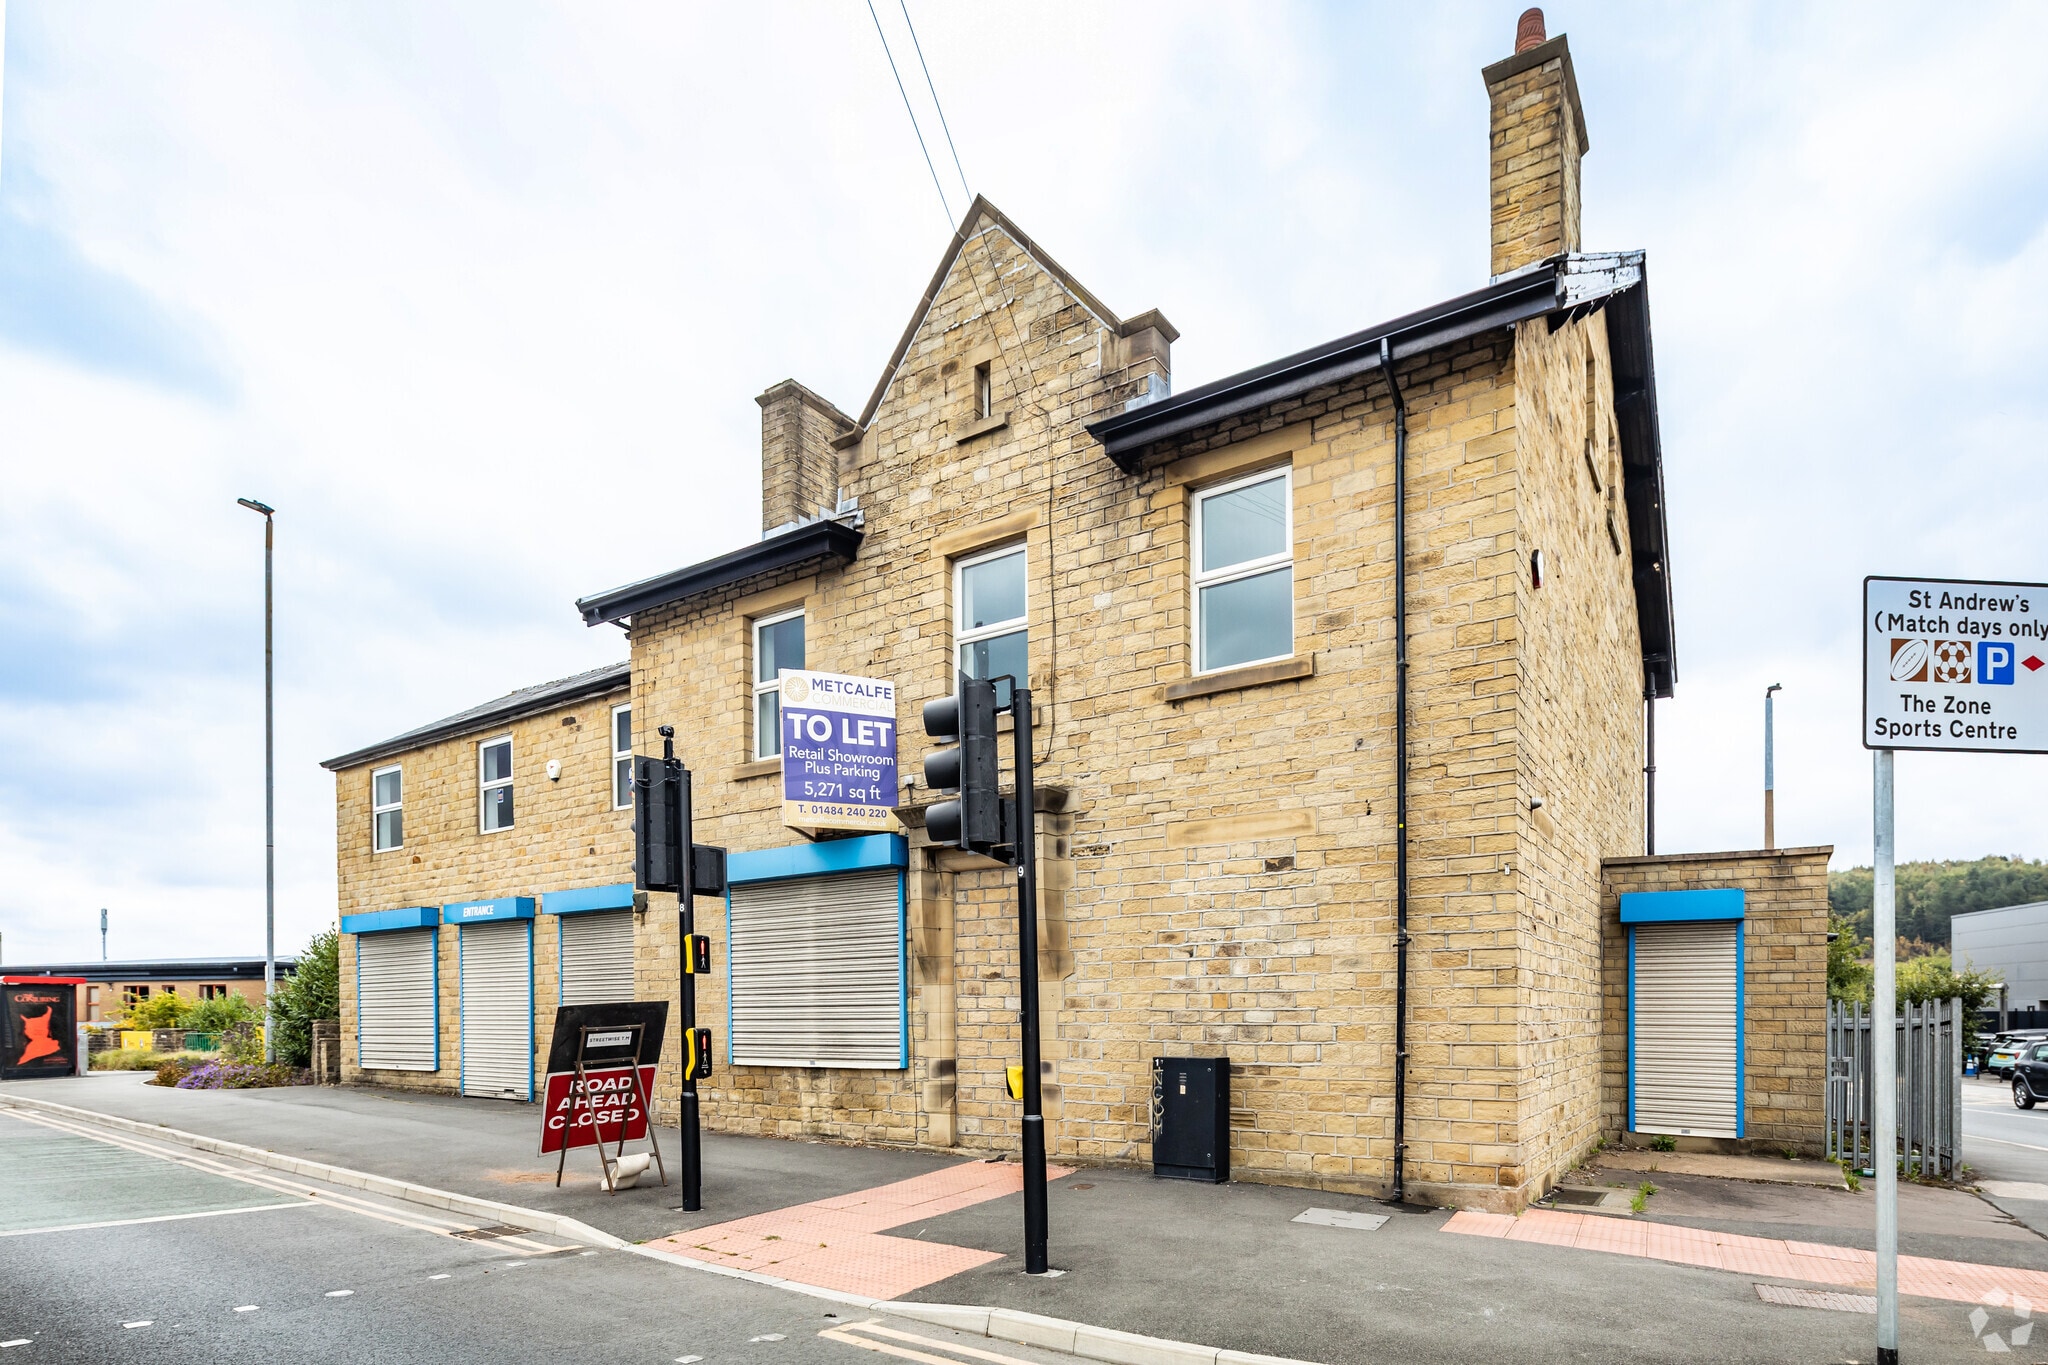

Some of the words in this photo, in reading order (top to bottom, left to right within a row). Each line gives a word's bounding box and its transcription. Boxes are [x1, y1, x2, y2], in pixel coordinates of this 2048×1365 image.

[1908, 590, 1931, 609] St
[1939, 591, 2030, 613] Andrew's
[1957, 616, 2002, 639] days
[1986, 646, 2009, 681] P
[812, 678, 892, 700] METCALFE
[812, 693, 893, 713] COMMERCIAL
[1900, 694, 1936, 713] The
[1943, 695, 1991, 715] Zone
[787, 712, 833, 742] TO
[842, 718, 892, 748] LET
[1874, 717, 1942, 740] Sports
[1950, 719, 2017, 740] Centre
[789, 745, 824, 761] Retail
[828, 748, 894, 766] Showroom
[805, 761, 831, 775] Plus
[834, 763, 880, 782] Parking
[804, 781, 843, 798] 5,271
[849, 787, 866, 803] sq
[869, 785, 881, 800] ft
[798, 804, 807, 814] T.
[811, 805, 843, 816] 01484
[846, 807, 866, 817] 240
[868, 808, 887, 819] 220
[1018, 865, 1024, 877] 9
[463, 904, 494, 918] ENTRANCE
[679, 903, 685, 912] 8
[568, 1076, 633, 1095] ROAD
[556, 1092, 637, 1112] AHEAD
[548, 1108, 640, 1130] CLOSED
